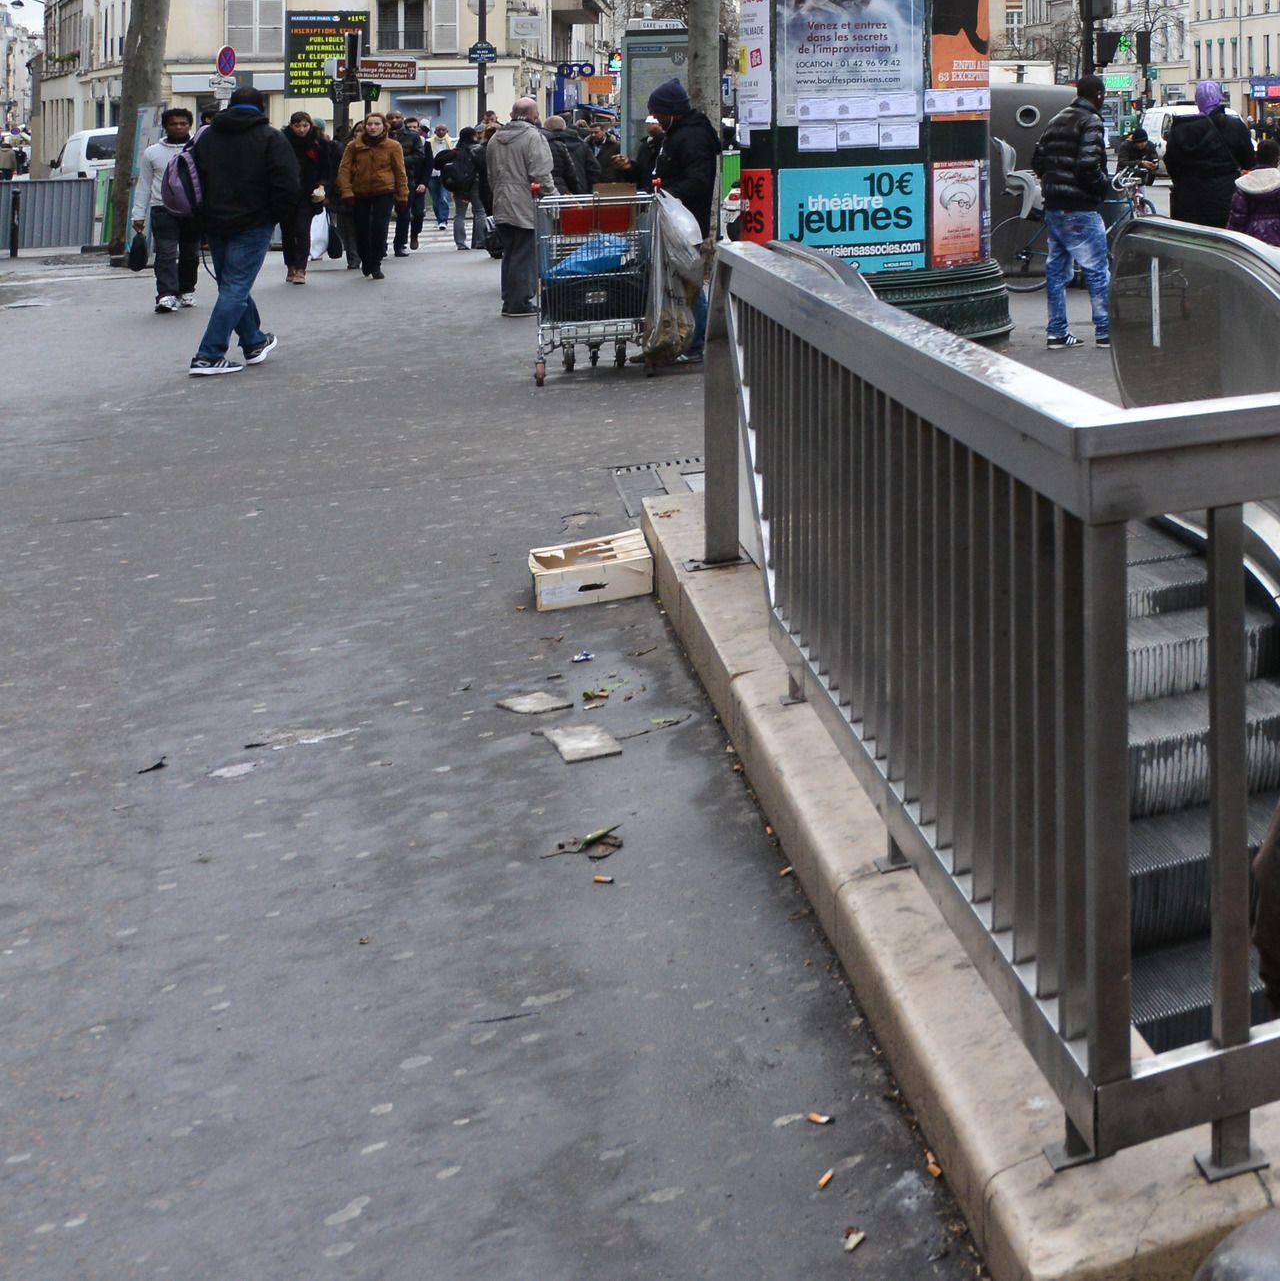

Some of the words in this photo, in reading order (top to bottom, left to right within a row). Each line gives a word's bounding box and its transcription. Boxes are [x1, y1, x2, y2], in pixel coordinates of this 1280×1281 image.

[808, 21, 838, 30] Venez
[841, 21, 850, 29] et
[855, 21, 887, 30] entrez
[807, 33, 831, 42] dans
[835, 32, 849, 41] les
[852, 32, 888, 41] secrets
[798, 45, 809, 54] de
[813, 43, 891, 56] l'improvisation
[674, 52, 683, 62] 18
[796, 60, 832, 69] LOCATION
[796, 76, 901, 85] www.bouffesparisiens.com
[938, 72, 949, 81] 63
[864, 172, 913, 197] 10€
[808, 193, 883, 211] théâtre
[789, 203, 913, 242] jeunes
